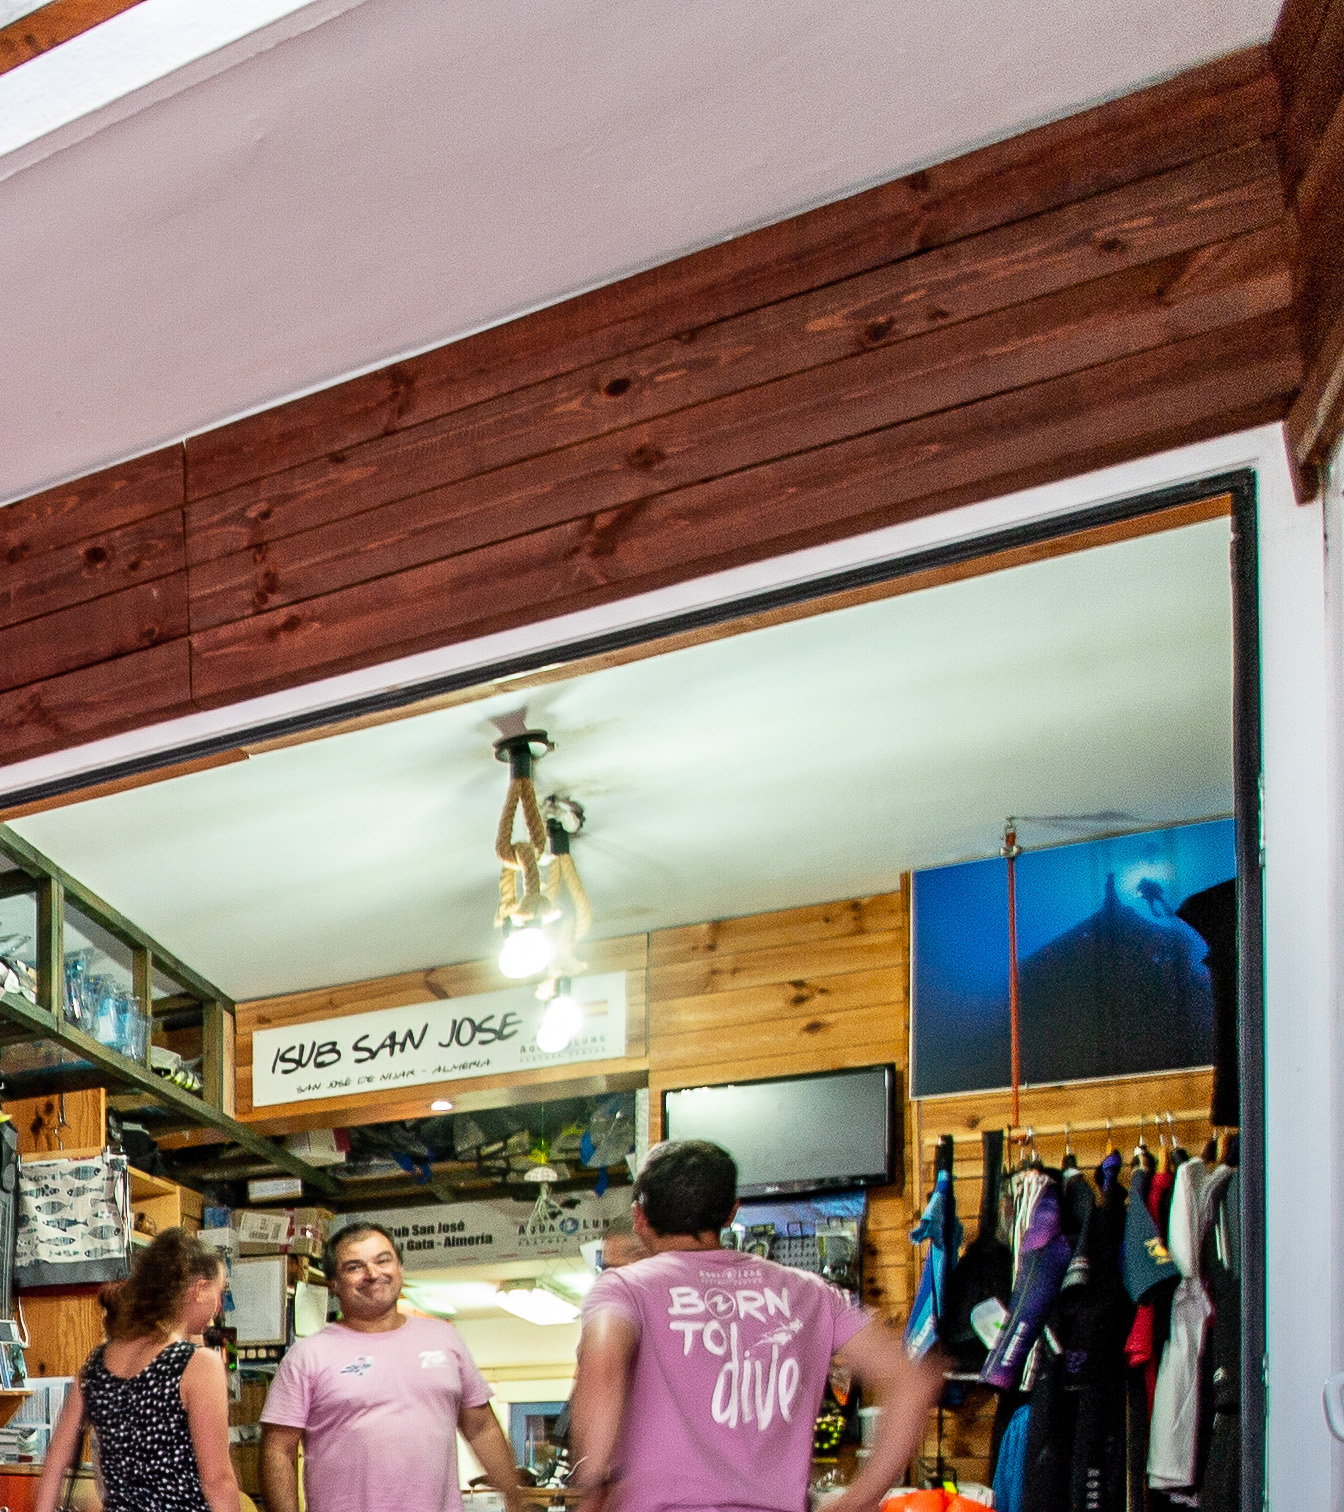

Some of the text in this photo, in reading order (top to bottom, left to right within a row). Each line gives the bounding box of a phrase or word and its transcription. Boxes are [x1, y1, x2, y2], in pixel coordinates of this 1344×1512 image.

[270, 1011, 523, 1075] ISUB SAN JOSE
[669, 1319, 728, 1357] TO
[711, 1321, 800, 1431] dive
